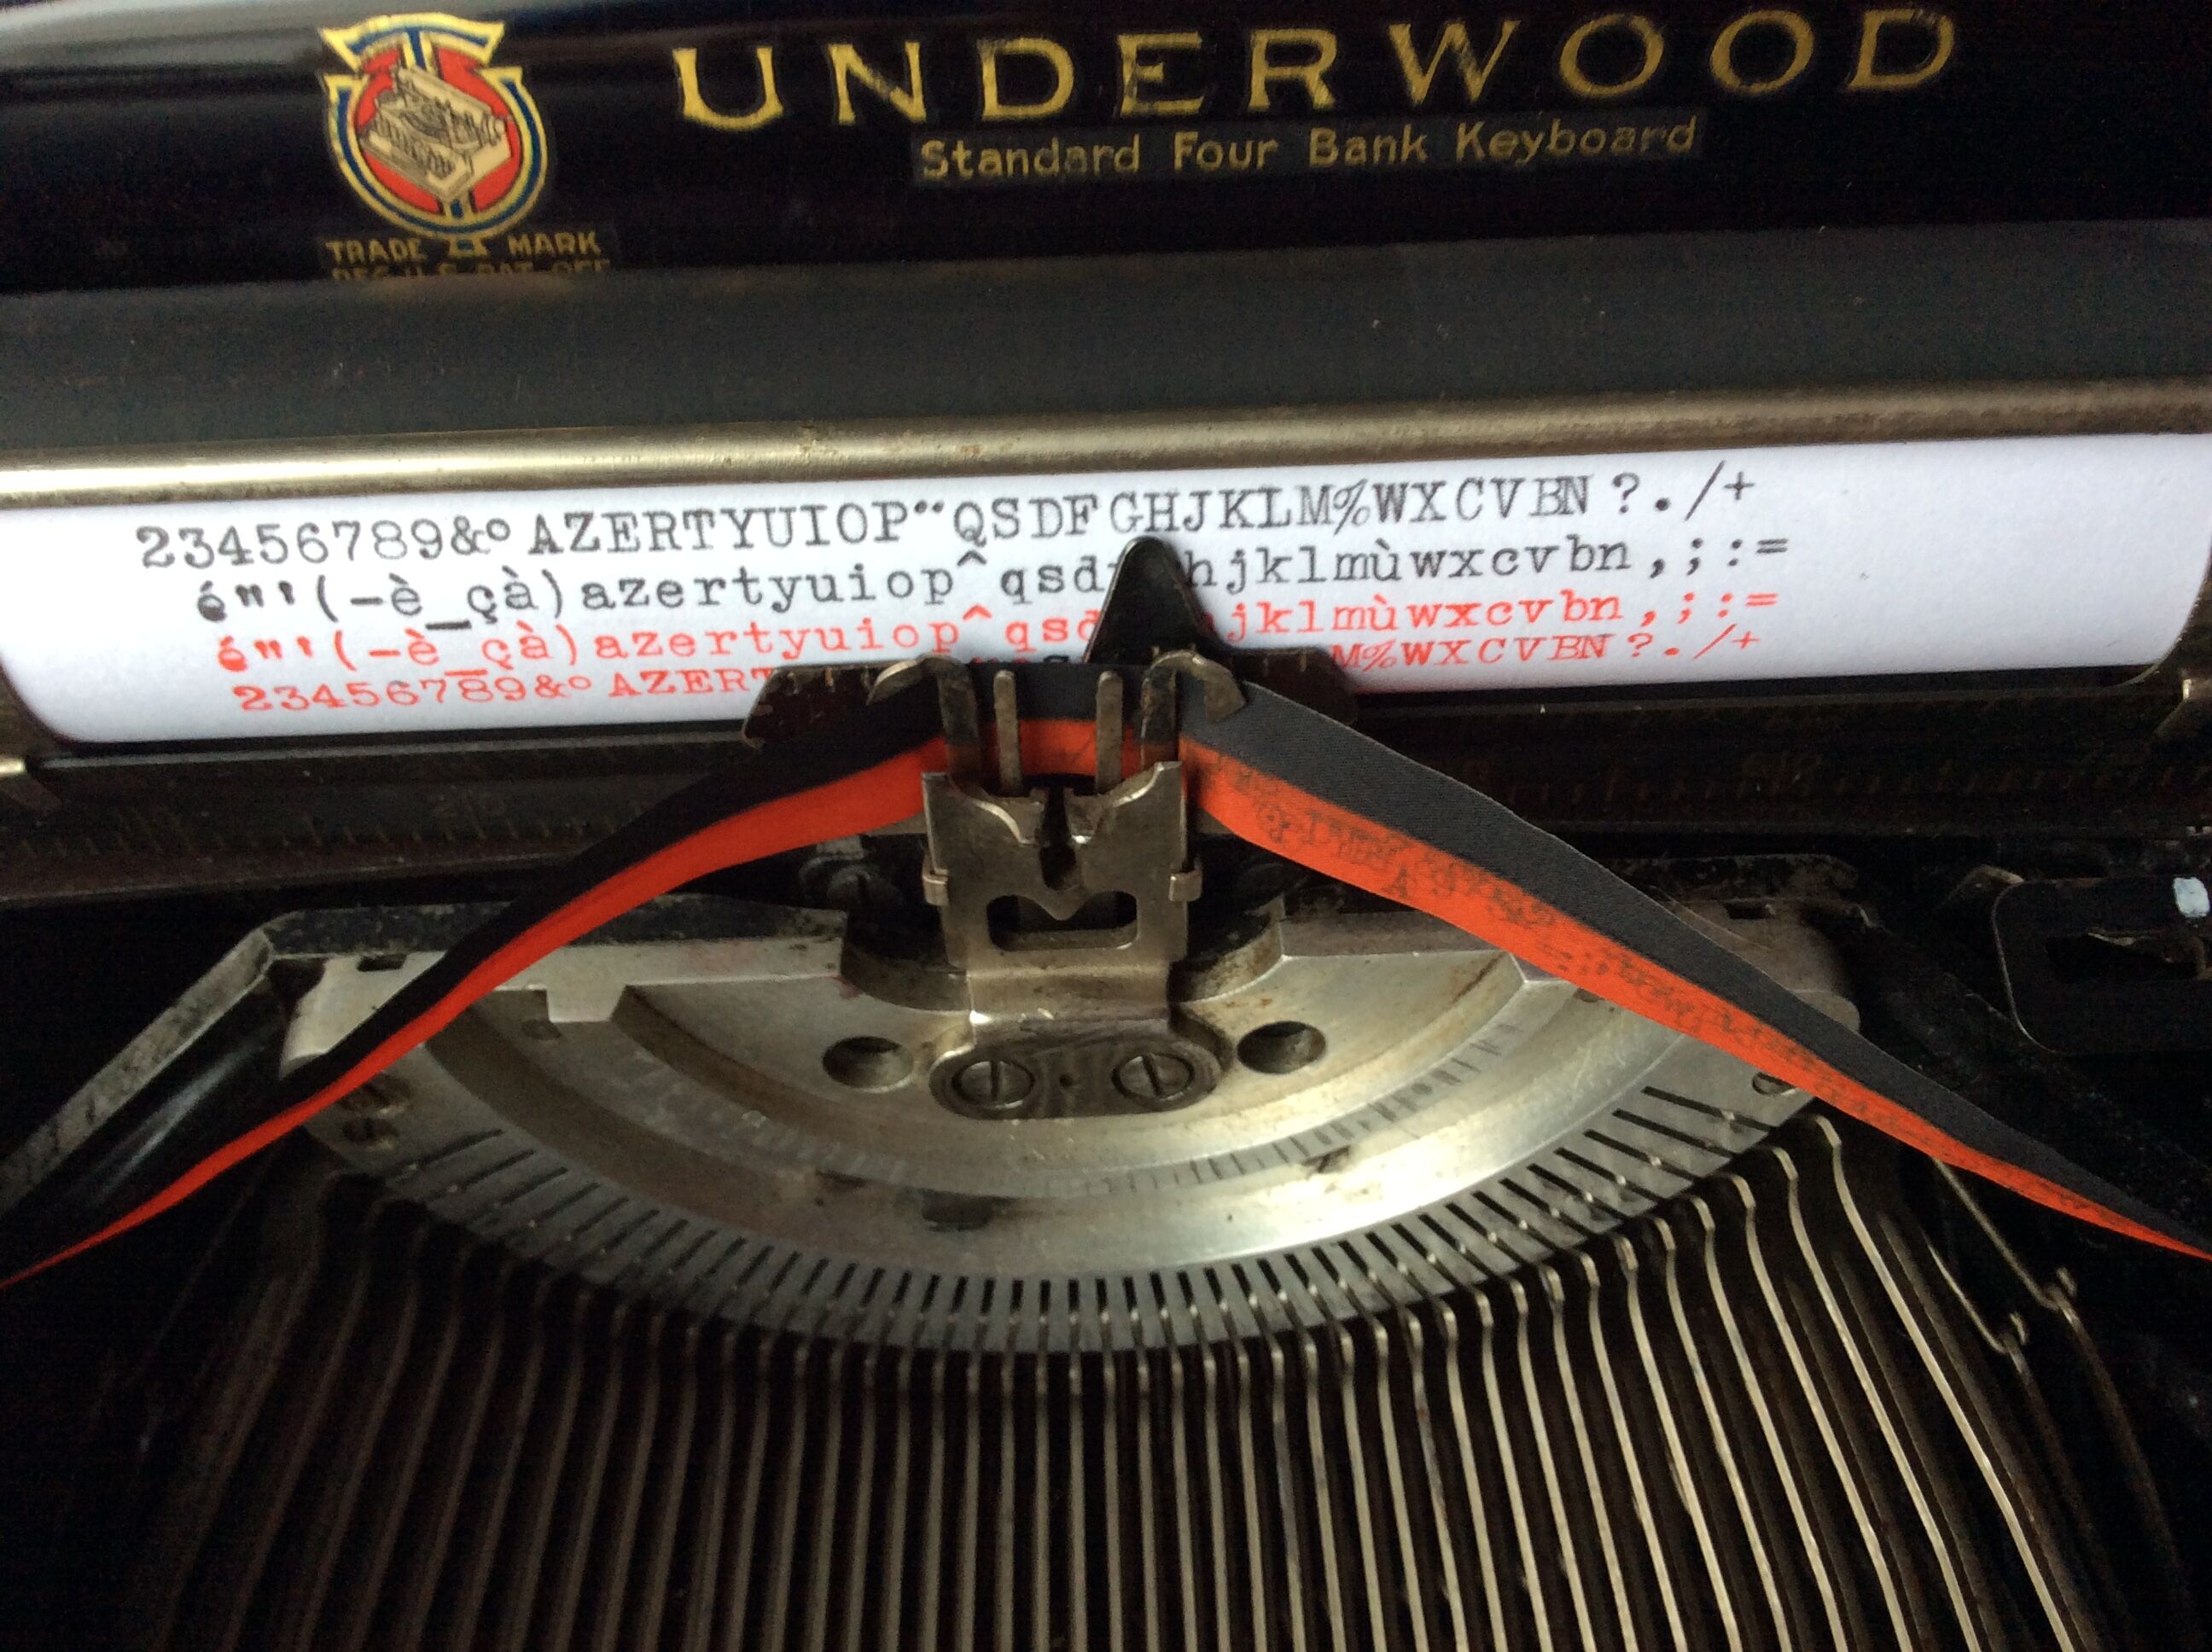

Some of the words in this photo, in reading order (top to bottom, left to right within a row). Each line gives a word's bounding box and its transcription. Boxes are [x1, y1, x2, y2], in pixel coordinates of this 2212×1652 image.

[672, 9, 1954, 131] UNDERWOOD
[920, 133, 1142, 180] Standard
[1172, 131, 1278, 171] Four
[1308, 125, 1428, 168] Bank
[1454, 114, 1699, 163] Keyboard
[325, 237, 426, 264] TRADE
[508, 231, 602, 256] MARK
